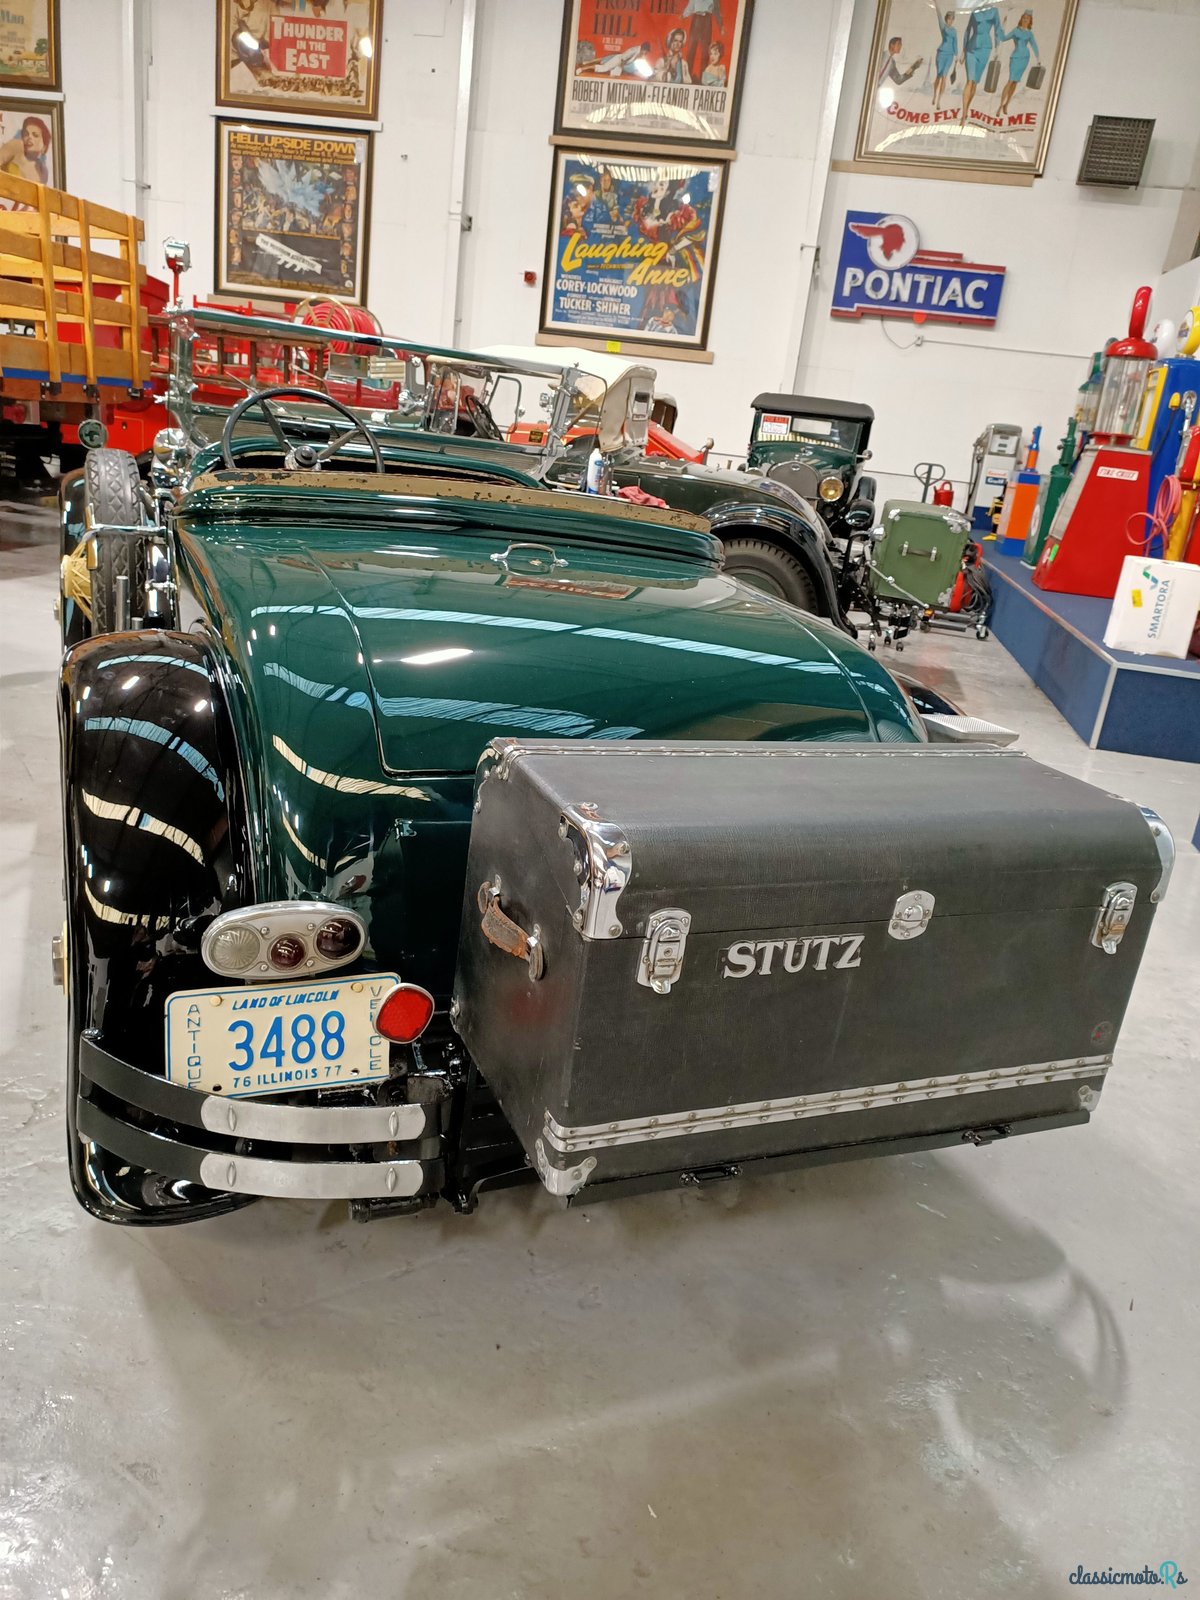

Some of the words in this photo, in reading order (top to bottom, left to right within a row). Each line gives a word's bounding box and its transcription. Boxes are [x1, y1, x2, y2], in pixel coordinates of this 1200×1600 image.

[272, 16, 344, 42] THUNDER
[593, 14, 637, 37] HILL
[296, 40, 306, 50] IN
[309, 41, 326, 52] THE
[286, 48, 330, 72] EAST
[572, 80, 604, 103] ROBERT
[606, 82, 647, 104] MITCHUM
[693, 89, 727, 112] PARKER
[934, 108, 960, 122] FLY
[1008, 112, 1038, 126] ME
[264, 136, 312, 150] UPSIDE
[314, 140, 356, 154] DOWN
[561, 232, 668, 272] Laughing
[626, 258, 689, 288] Anne
[556, 278, 586, 292] COREY
[587, 282, 638, 298] LOCKWOOD
[842, 267, 988, 310] PONTIAC
[560, 296, 592, 311] TUCKER
[596, 301, 630, 316] SHINER
[1148, 580, 1170, 639] SMARTORA
[722, 934, 866, 979] STUTZ
[232, 997, 266, 1010] LAND
[268, 995, 284, 1007] OF
[285, 990, 339, 1006] LINCOLN
[369, 986, 382, 1070] VECLE
[228, 1010, 345, 1072] 3488
[234, 1076, 252, 1088] 76
[258, 1068, 318, 1085] ILLINOIS
[325, 1065, 342, 1078] 77
